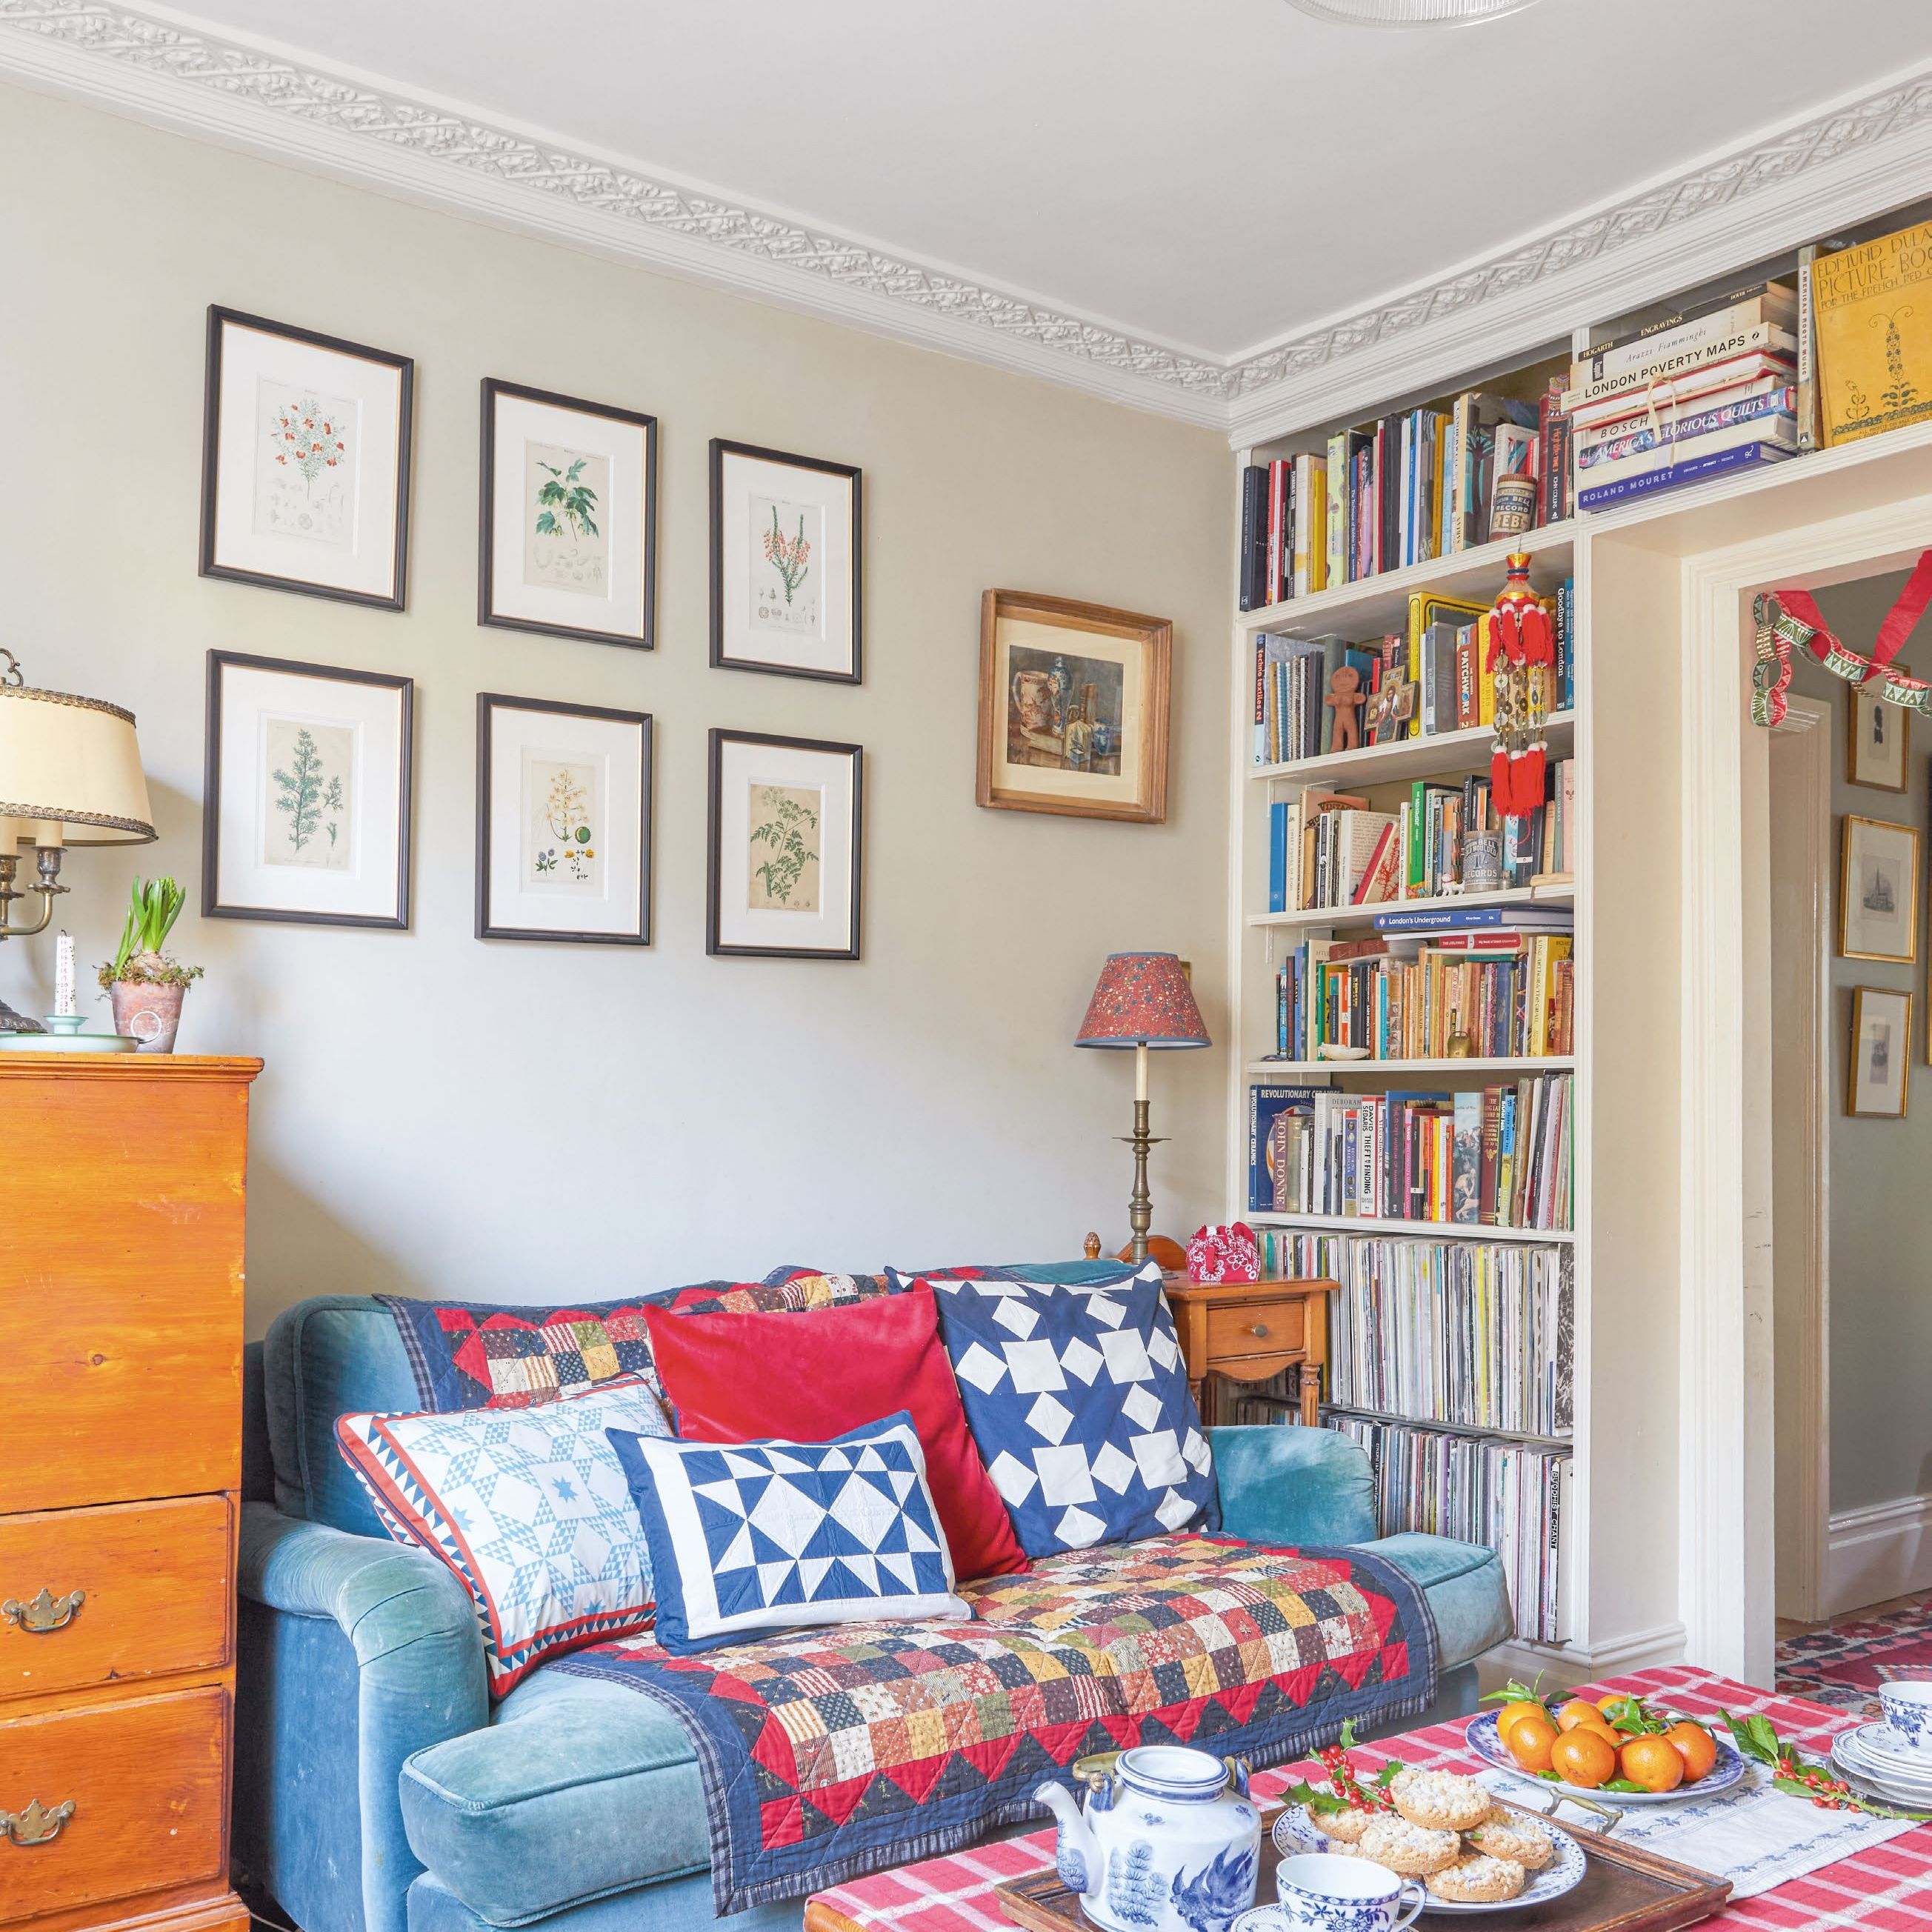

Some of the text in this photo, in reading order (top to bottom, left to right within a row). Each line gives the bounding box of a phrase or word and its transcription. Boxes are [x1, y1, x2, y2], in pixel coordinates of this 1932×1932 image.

[1817, 245, 1882, 279] EDMUND
[1842, 291, 1859, 303] THE
[1862, 276, 1898, 296] FRENCH
[1583, 341, 1613, 358] HOGARTH
[1640, 314, 1683, 336] ENGRAVINGS
[1585, 335, 1745, 399] LONDON POVERTY MAPS
[1595, 430, 1653, 458] AMERICA'S
[1721, 399, 1765, 422] QUILTS
[1600, 416, 1649, 439] BOSCH
[1582, 471, 1673, 503] ROLAND MOURET
[1512, 496, 1530, 507] BELL
[1558, 630, 1565, 639] to
[1461, 650, 1470, 716] PATCHWORK
[1256, 713, 1262, 721] 2
[1478, 839, 1496, 849] BELL
[1413, 916, 1450, 925] Underground
[1261, 1089, 1310, 1099] REVOLUTIONARY
[1276, 1119, 1286, 1205] JOHN DONNE
